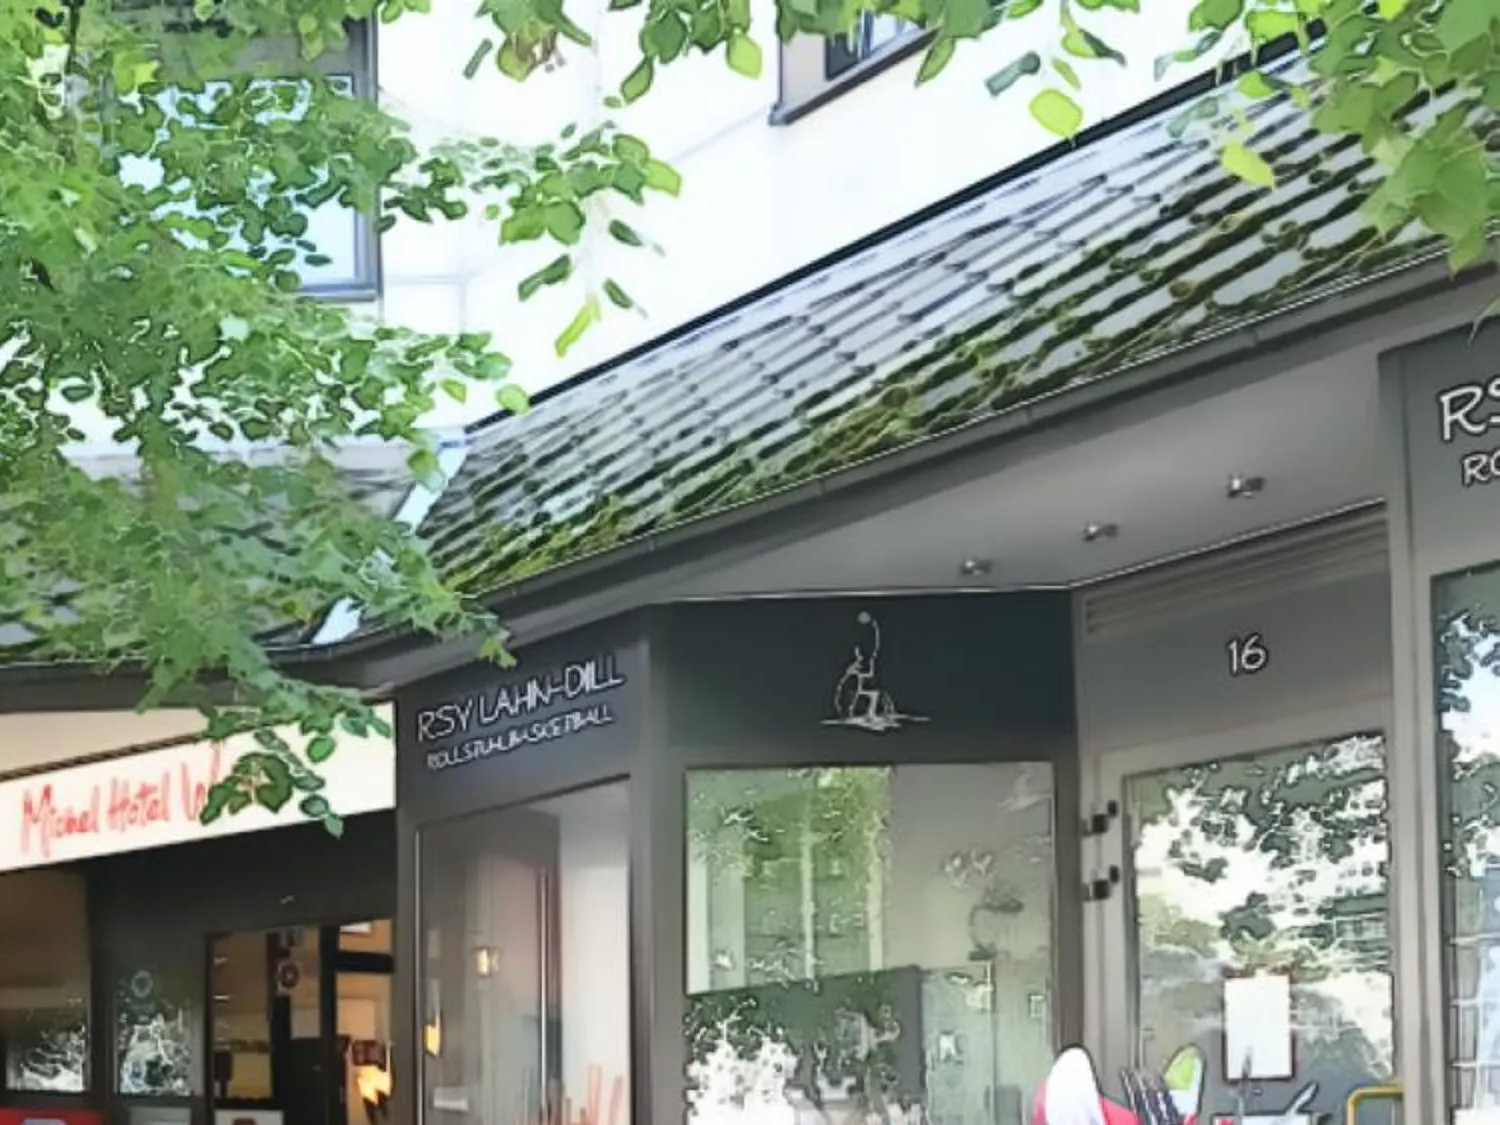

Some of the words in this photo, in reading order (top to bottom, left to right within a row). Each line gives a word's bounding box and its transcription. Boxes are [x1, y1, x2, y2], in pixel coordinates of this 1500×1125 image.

[1228, 635, 1266, 673] 16
[479, 655, 625, 723] LAHN-DILL
[105, 770, 172, 832] Hotel
